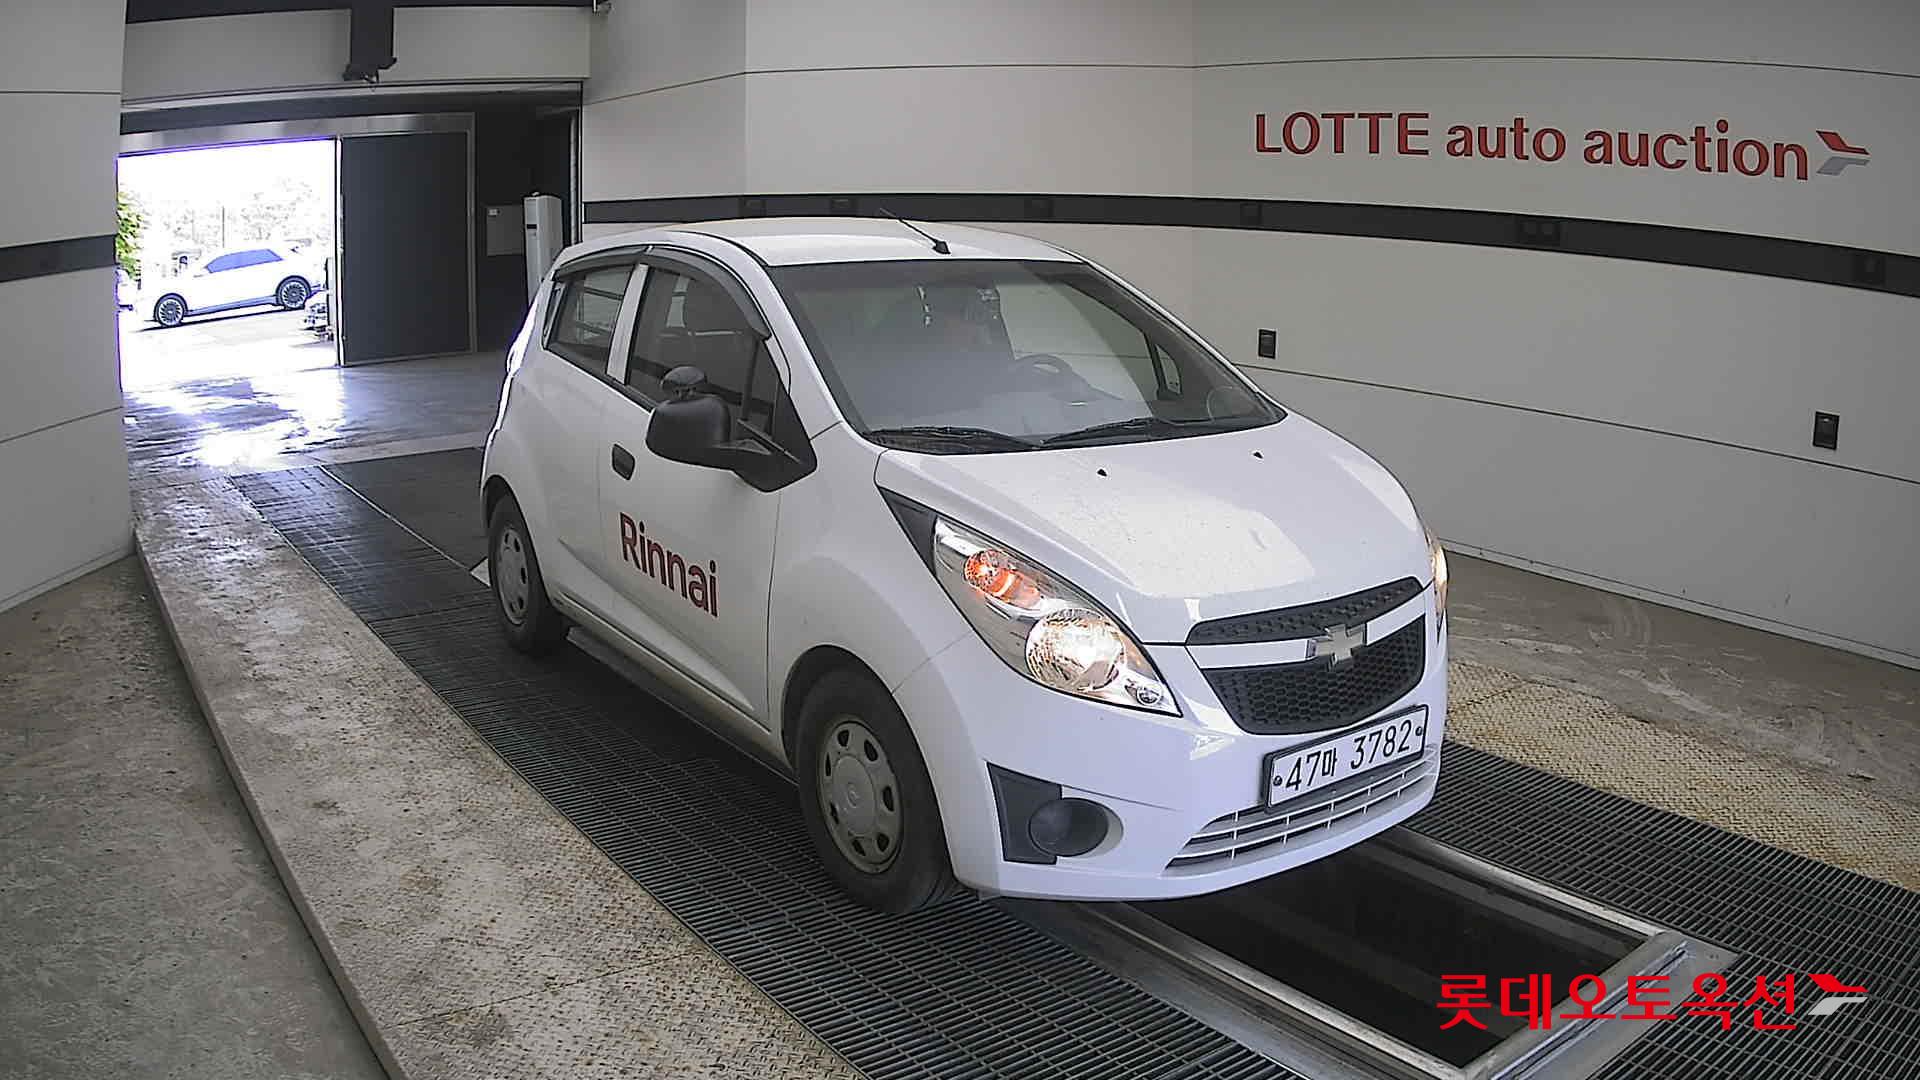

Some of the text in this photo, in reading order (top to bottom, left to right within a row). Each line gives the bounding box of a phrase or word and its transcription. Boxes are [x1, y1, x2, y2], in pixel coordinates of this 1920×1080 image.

[1255, 112, 1809, 180] LOTTE auto auction
[620, 511, 718, 618] Rinnai
[1286, 719, 1412, 790] 47마 3782
